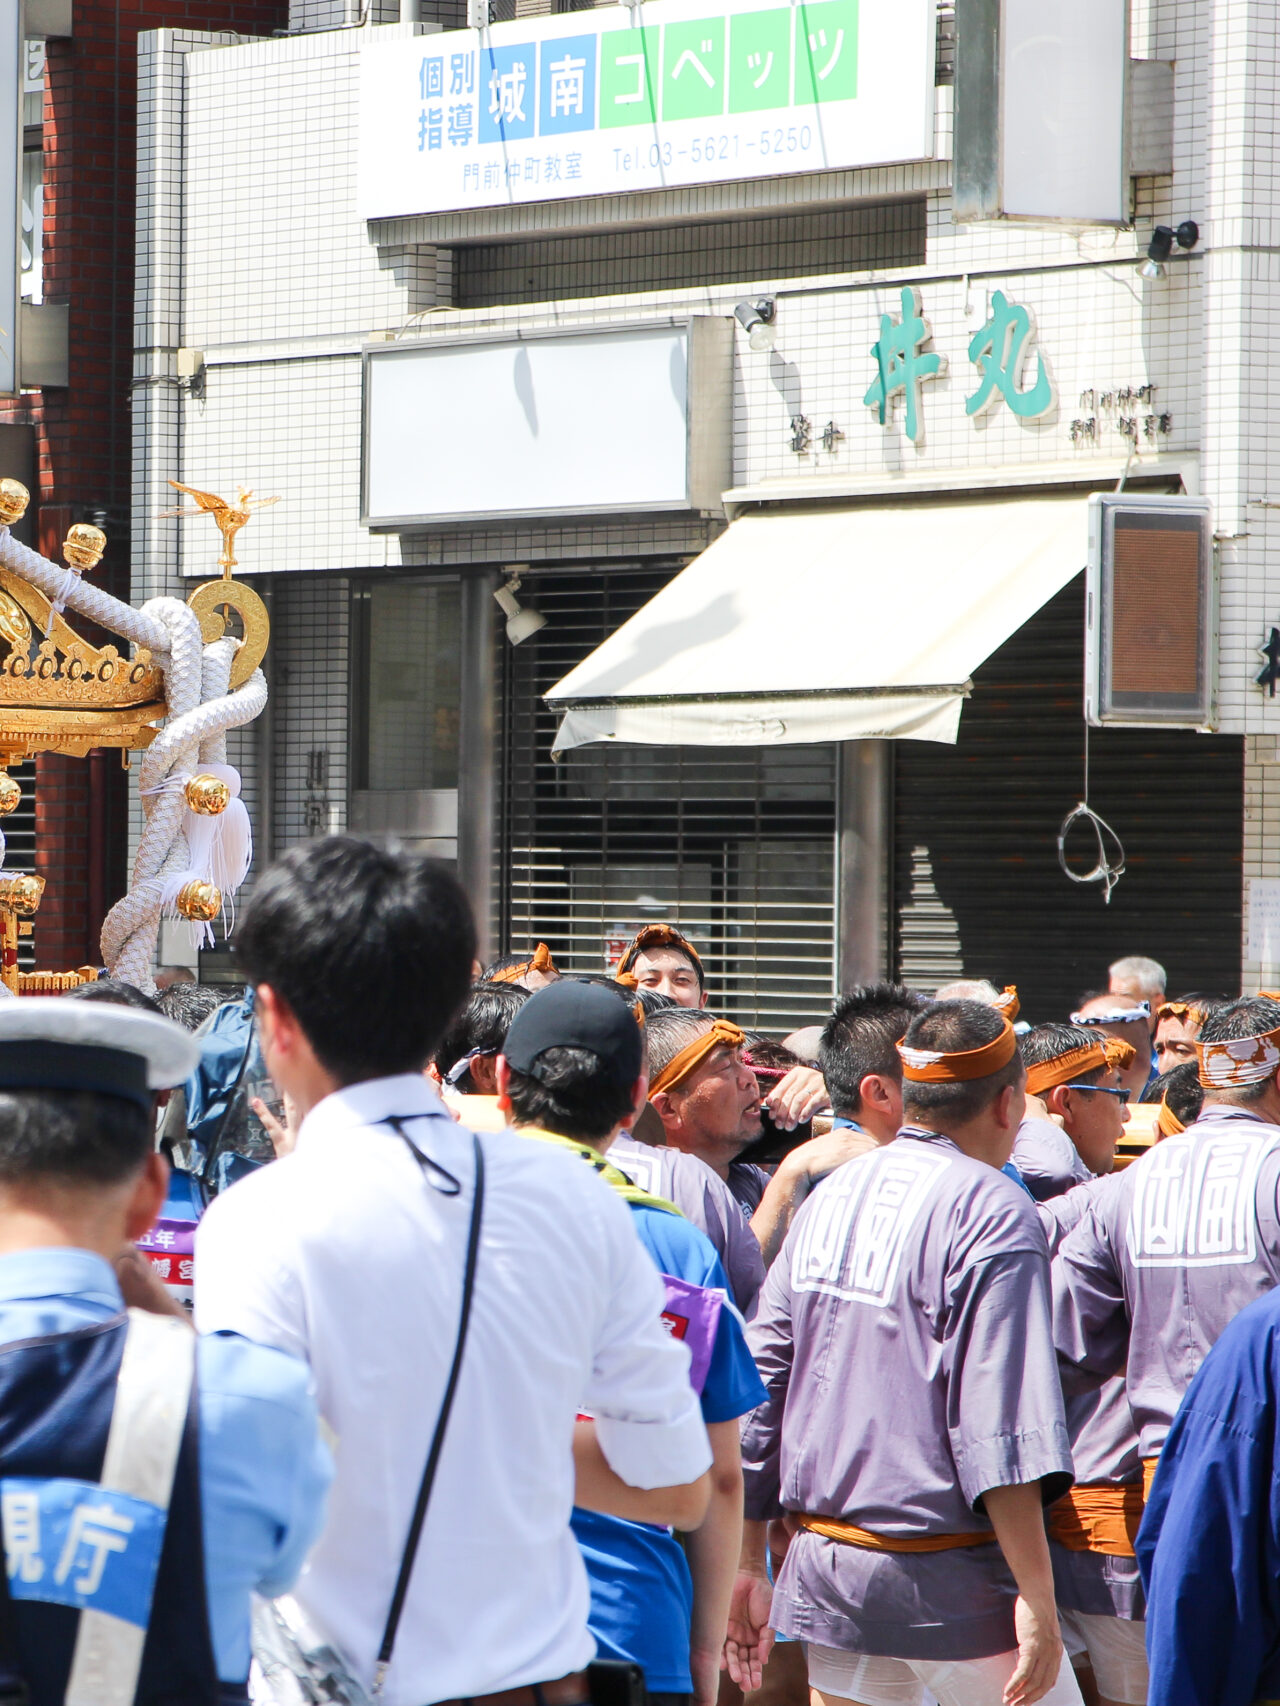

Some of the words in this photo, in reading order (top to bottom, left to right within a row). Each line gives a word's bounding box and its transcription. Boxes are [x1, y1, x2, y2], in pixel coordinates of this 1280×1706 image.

[419, 50, 475, 100] 個別
[417, 102, 474, 152] 指導
[462, 152, 583, 192] 門前仲町教室
